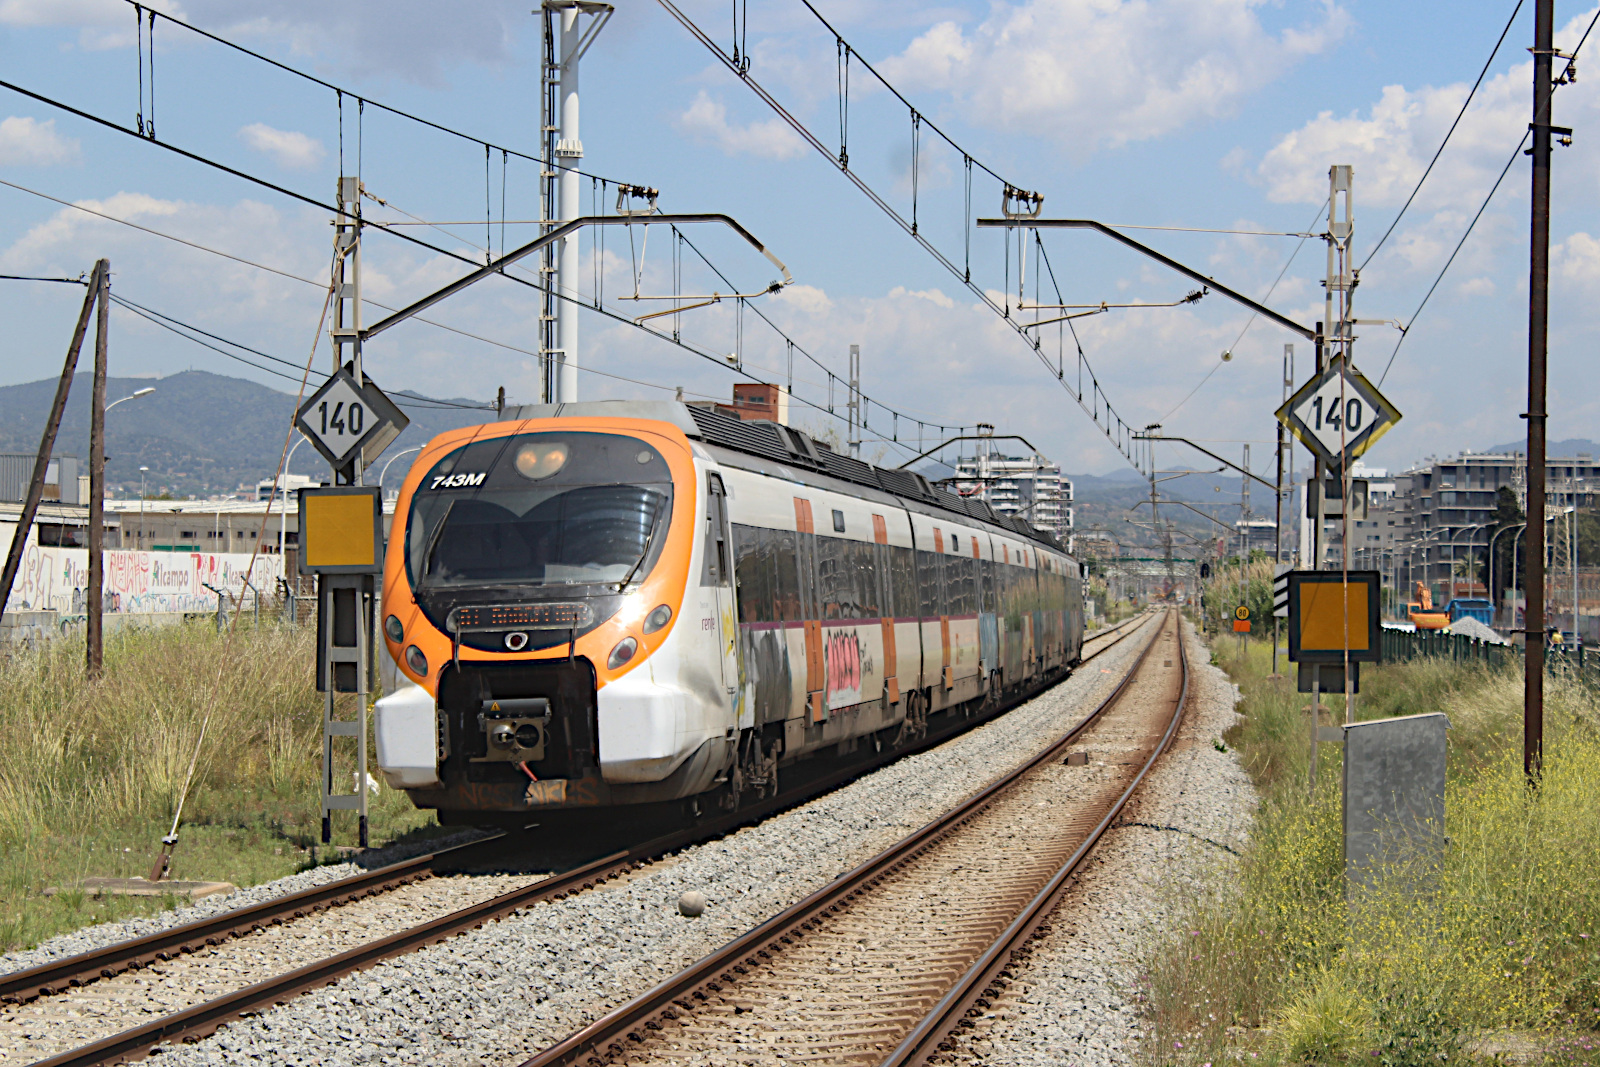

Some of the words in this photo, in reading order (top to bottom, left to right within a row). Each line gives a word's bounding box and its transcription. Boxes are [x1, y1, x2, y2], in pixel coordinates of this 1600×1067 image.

[318, 401, 364, 437] 140
[1312, 396, 1362, 433] 140
[430, 473, 487, 490] 743M
[151, 560, 189, 591] Alcampo
[1238, 608, 1247, 617] 80
